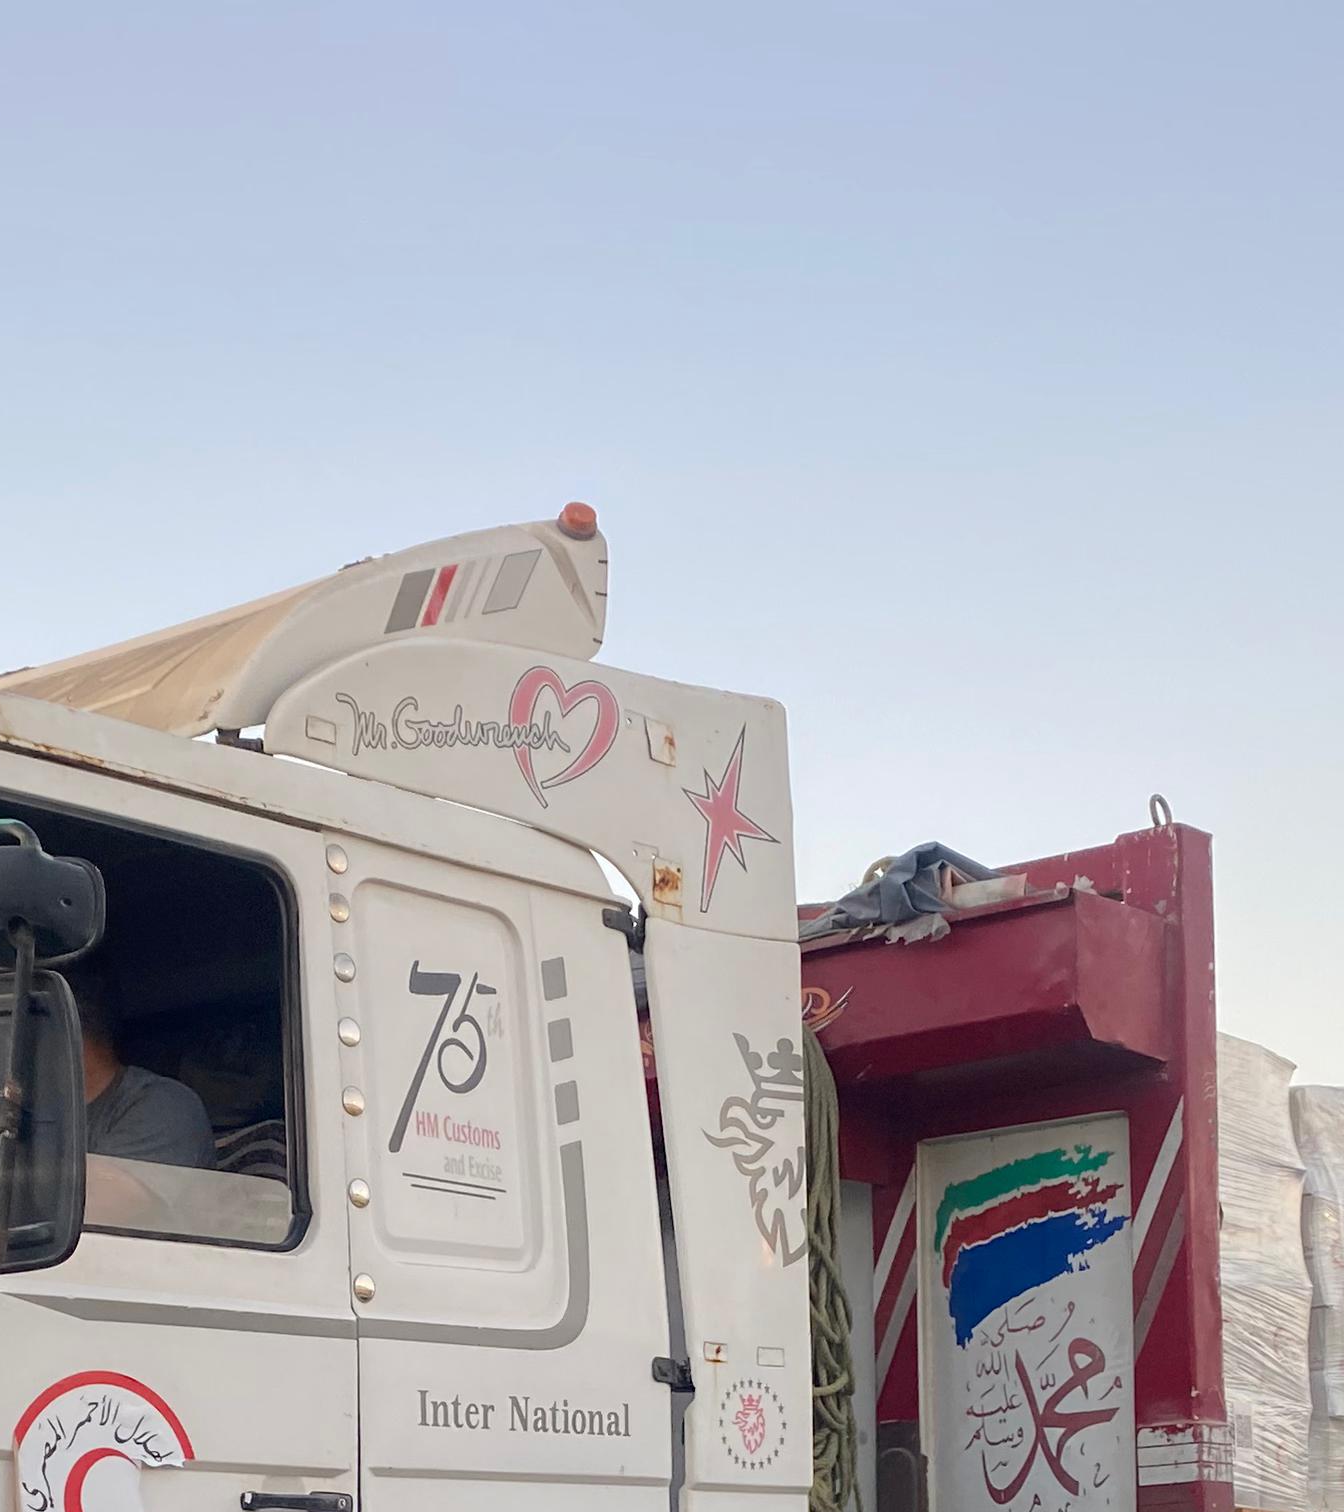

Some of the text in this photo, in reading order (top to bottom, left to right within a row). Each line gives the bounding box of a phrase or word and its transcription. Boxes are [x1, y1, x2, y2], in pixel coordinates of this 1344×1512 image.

[392, 696, 570, 753] Goodwrench
[415, 1110, 502, 1150] HM Customs
[444, 1153, 503, 1183] and Excise
[417, 1390, 632, 1438] Inter National
